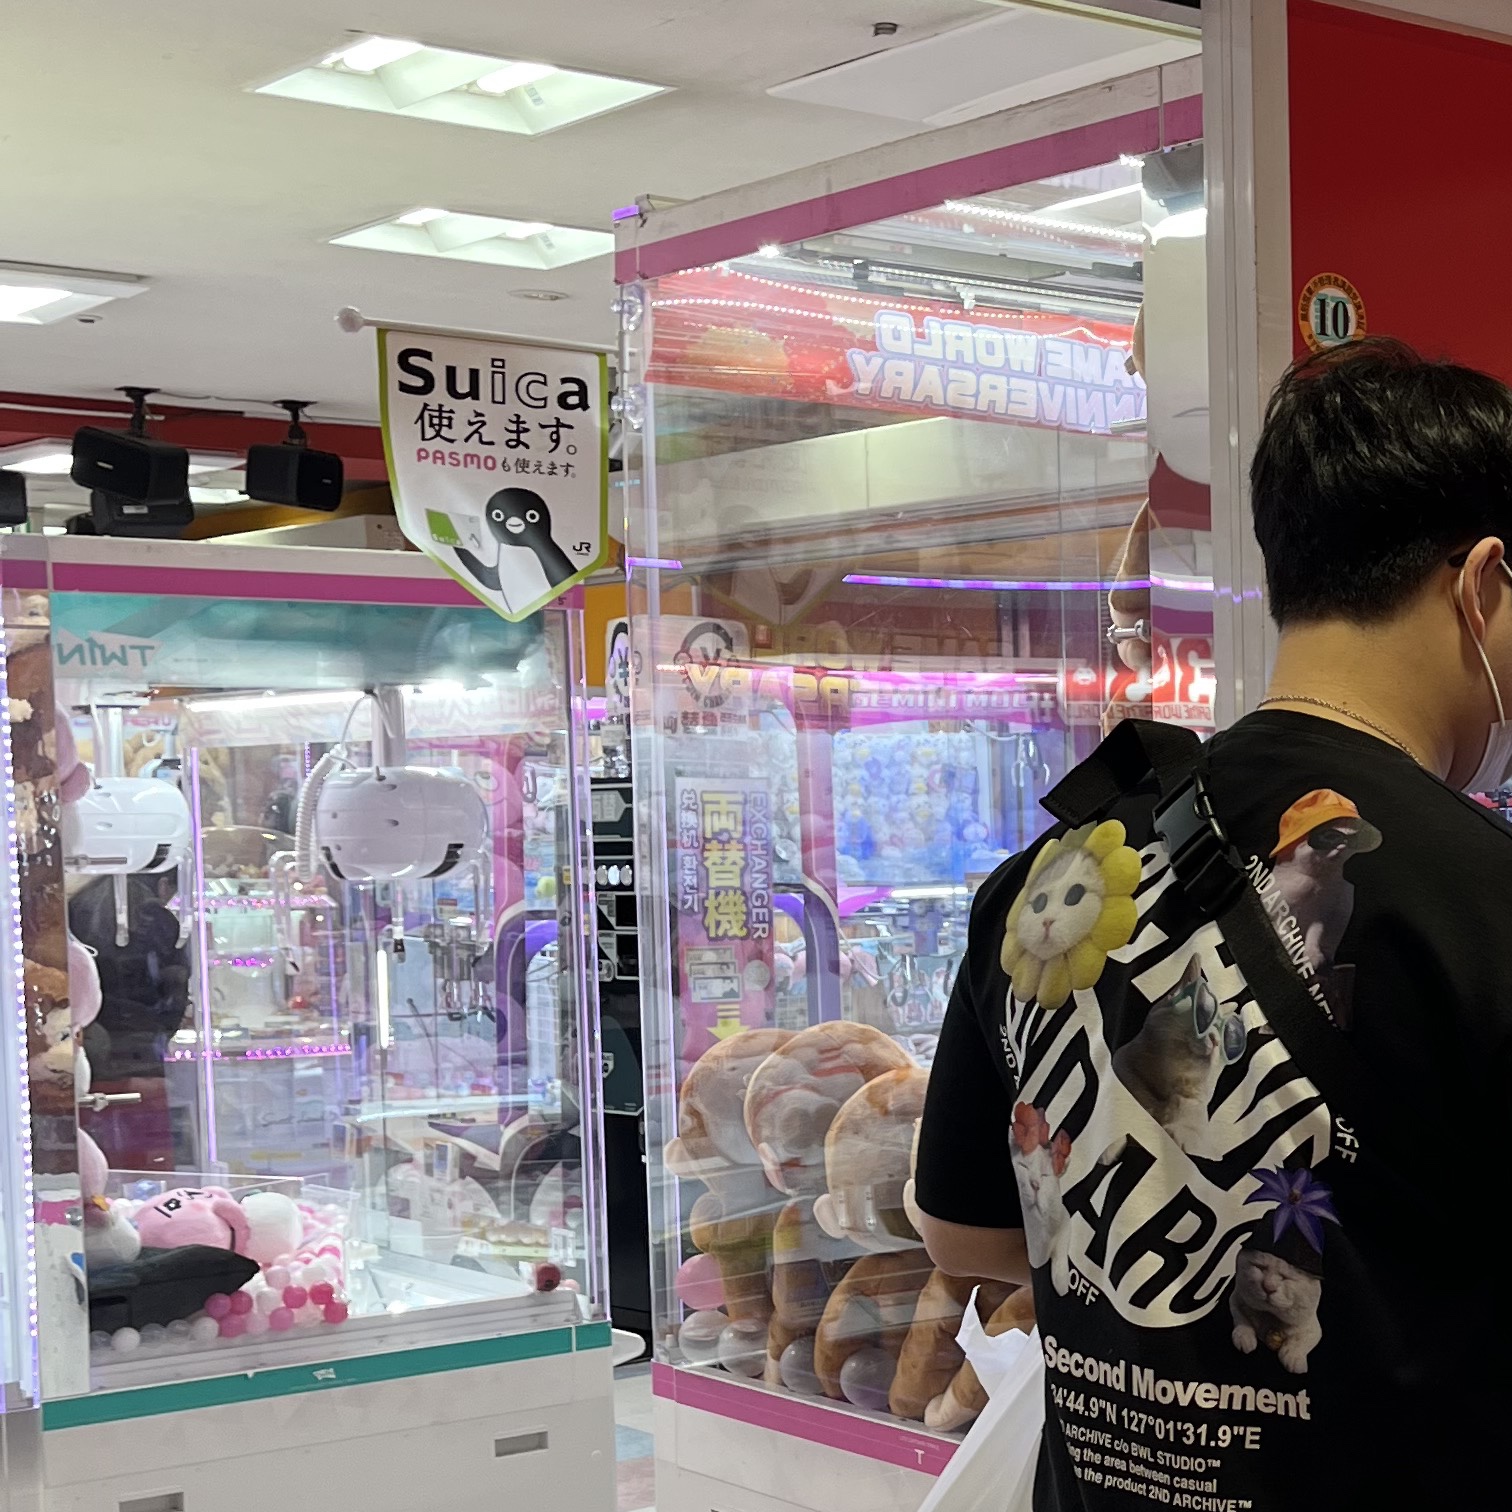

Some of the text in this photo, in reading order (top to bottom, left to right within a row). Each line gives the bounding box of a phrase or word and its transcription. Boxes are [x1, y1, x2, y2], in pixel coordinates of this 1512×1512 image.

[1315, 298, 1350, 339] 10
[397, 347, 591, 412] Suica
[414, 402, 577, 454] 使えます。
[701, 790, 748, 940] 両替機
[750, 791, 770, 940] EXCHANGER
[1066, 1267, 1100, 1306] OFF
[1044, 1335, 1311, 1421] Second Movement
[1065, 1421, 1112, 1449] ARCHIVE
[1130, 1442, 1155, 1463] BWL
[1082, 1447, 1101, 1465] the
[1103, 1455, 1127, 1472] area
[1129, 1459, 1171, 1485] between
[1172, 1473, 1218, 1494] casual
[1083, 1468, 1103, 1485] the
[1104, 1474, 1147, 1497] product
[1148, 1484, 1171, 1504] 2ND
